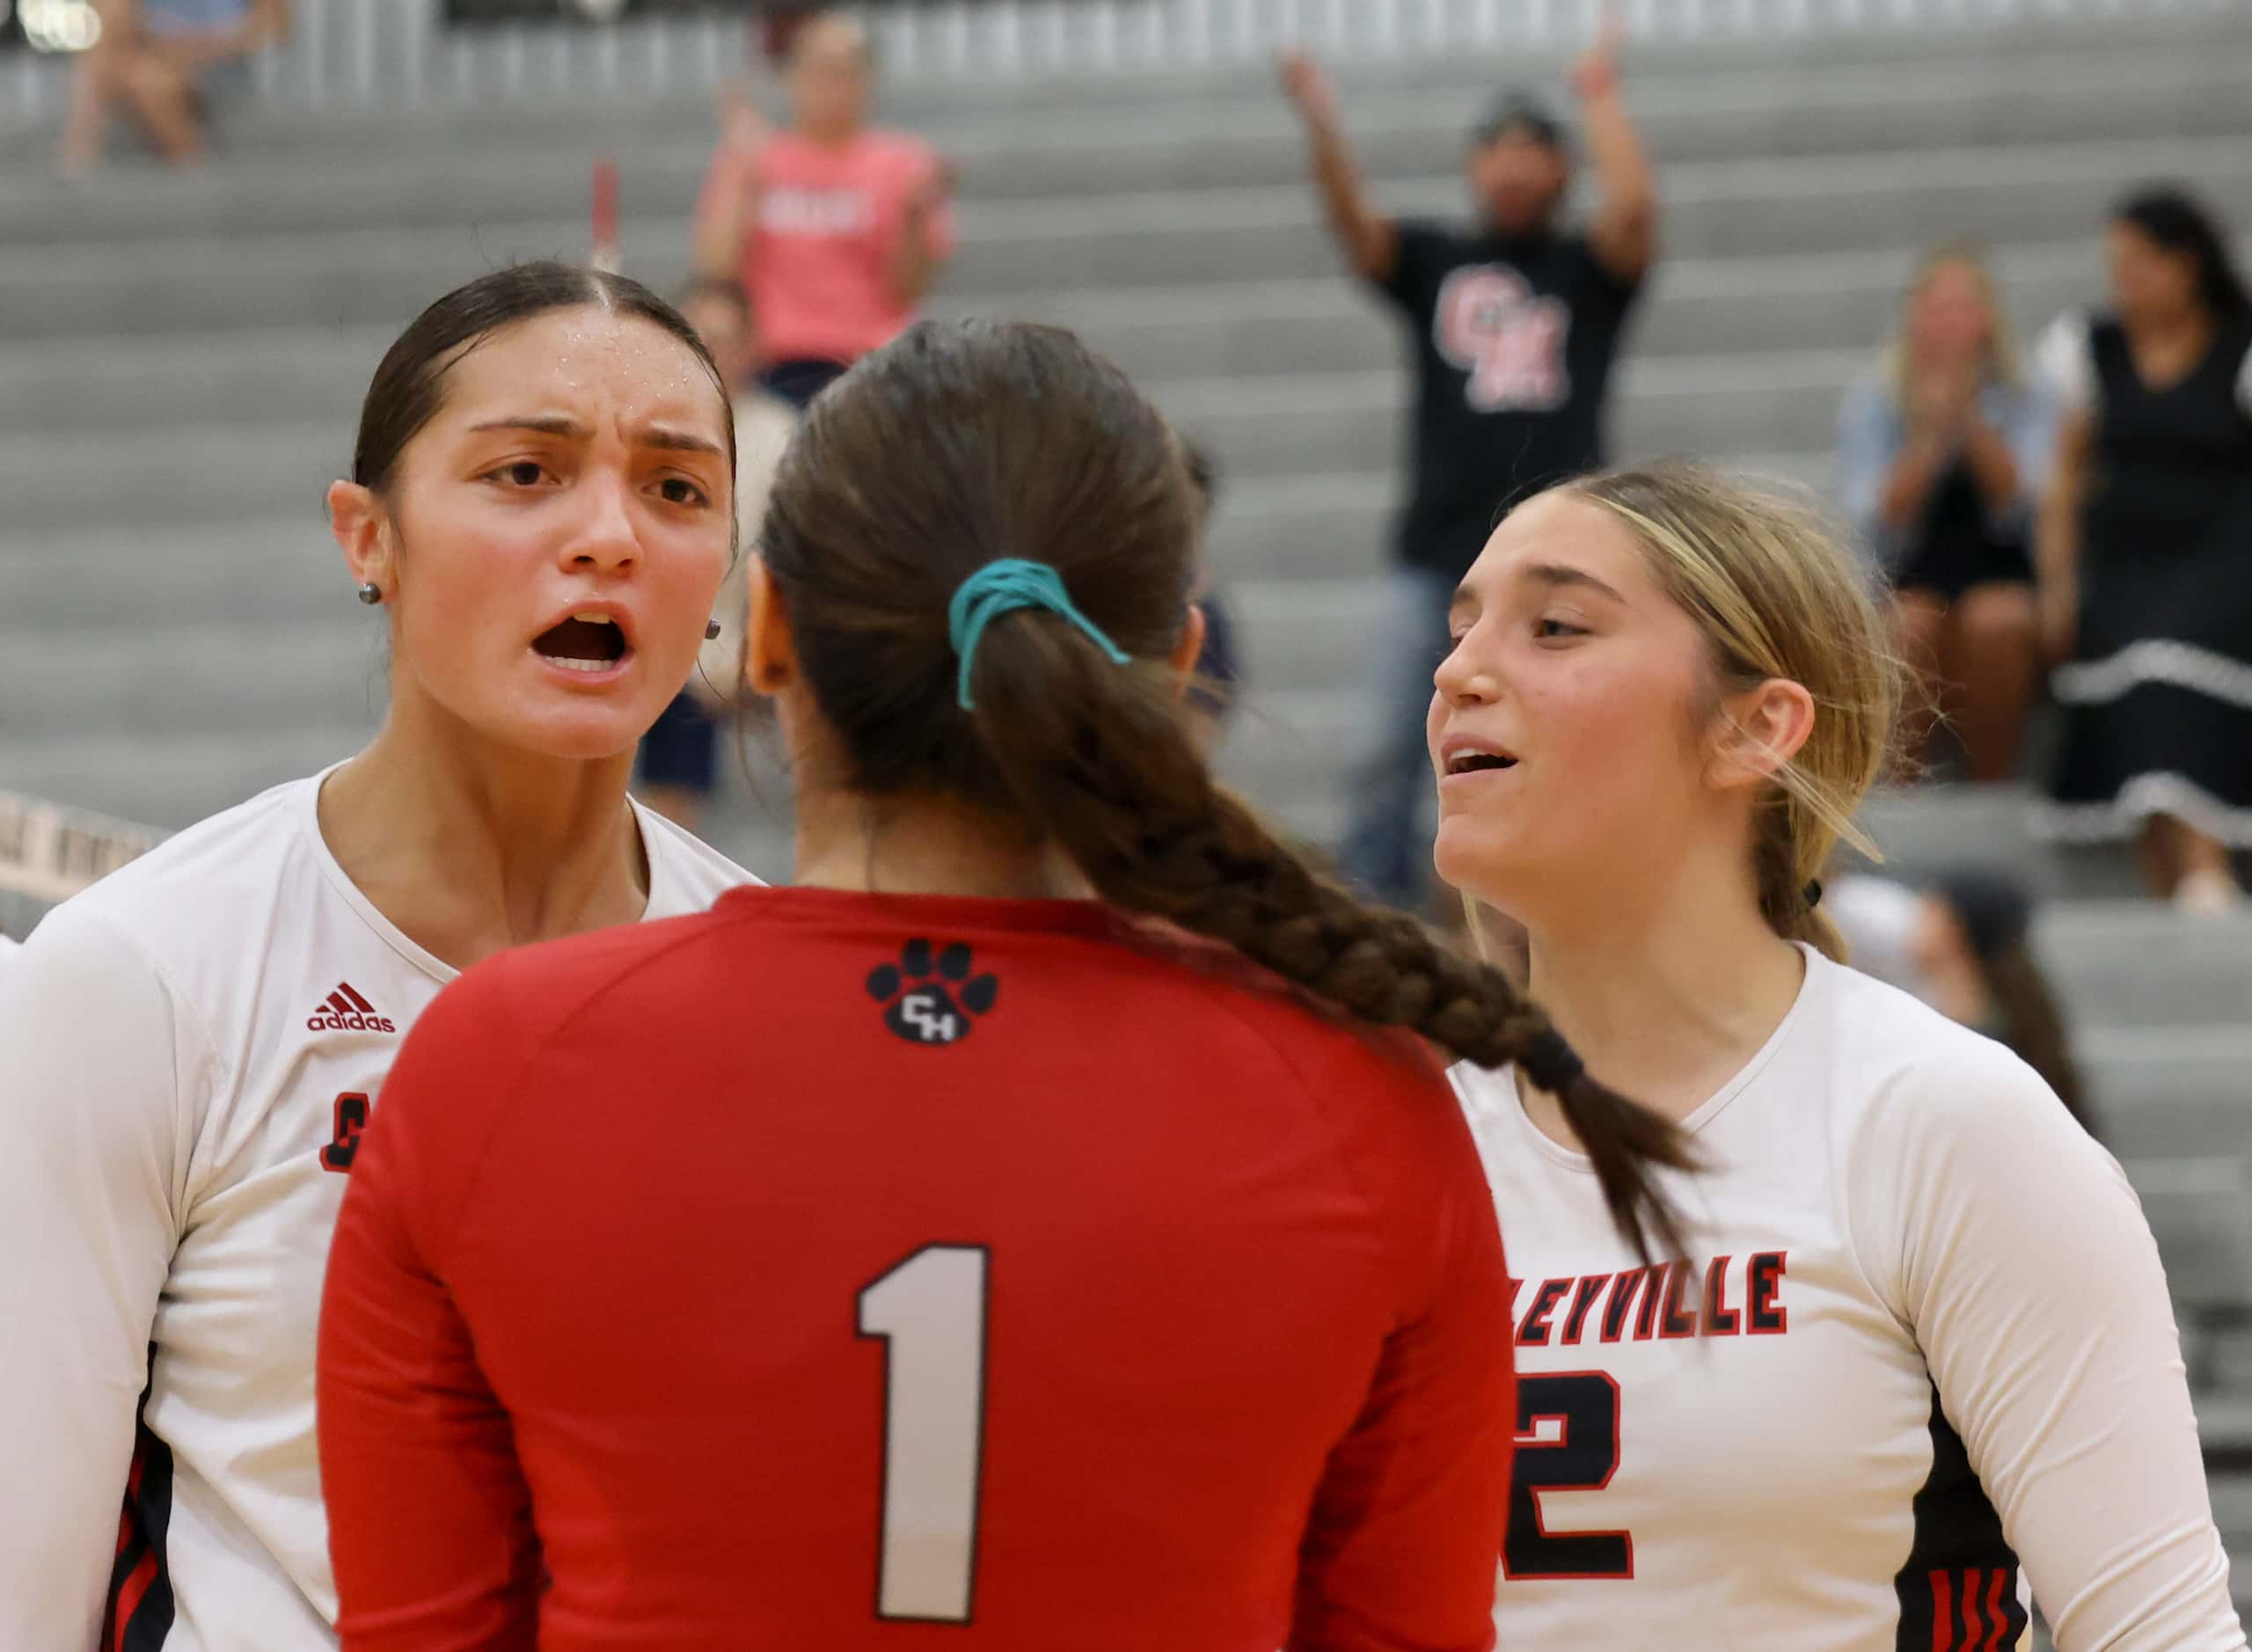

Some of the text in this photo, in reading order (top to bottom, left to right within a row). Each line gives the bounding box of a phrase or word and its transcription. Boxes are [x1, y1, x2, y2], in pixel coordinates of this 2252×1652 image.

[307, 1012, 396, 1033] adidas
[901, 994, 955, 1042] CH
[857, 1241, 991, 1625] 1
[1501, 1371, 1634, 1581] 2
